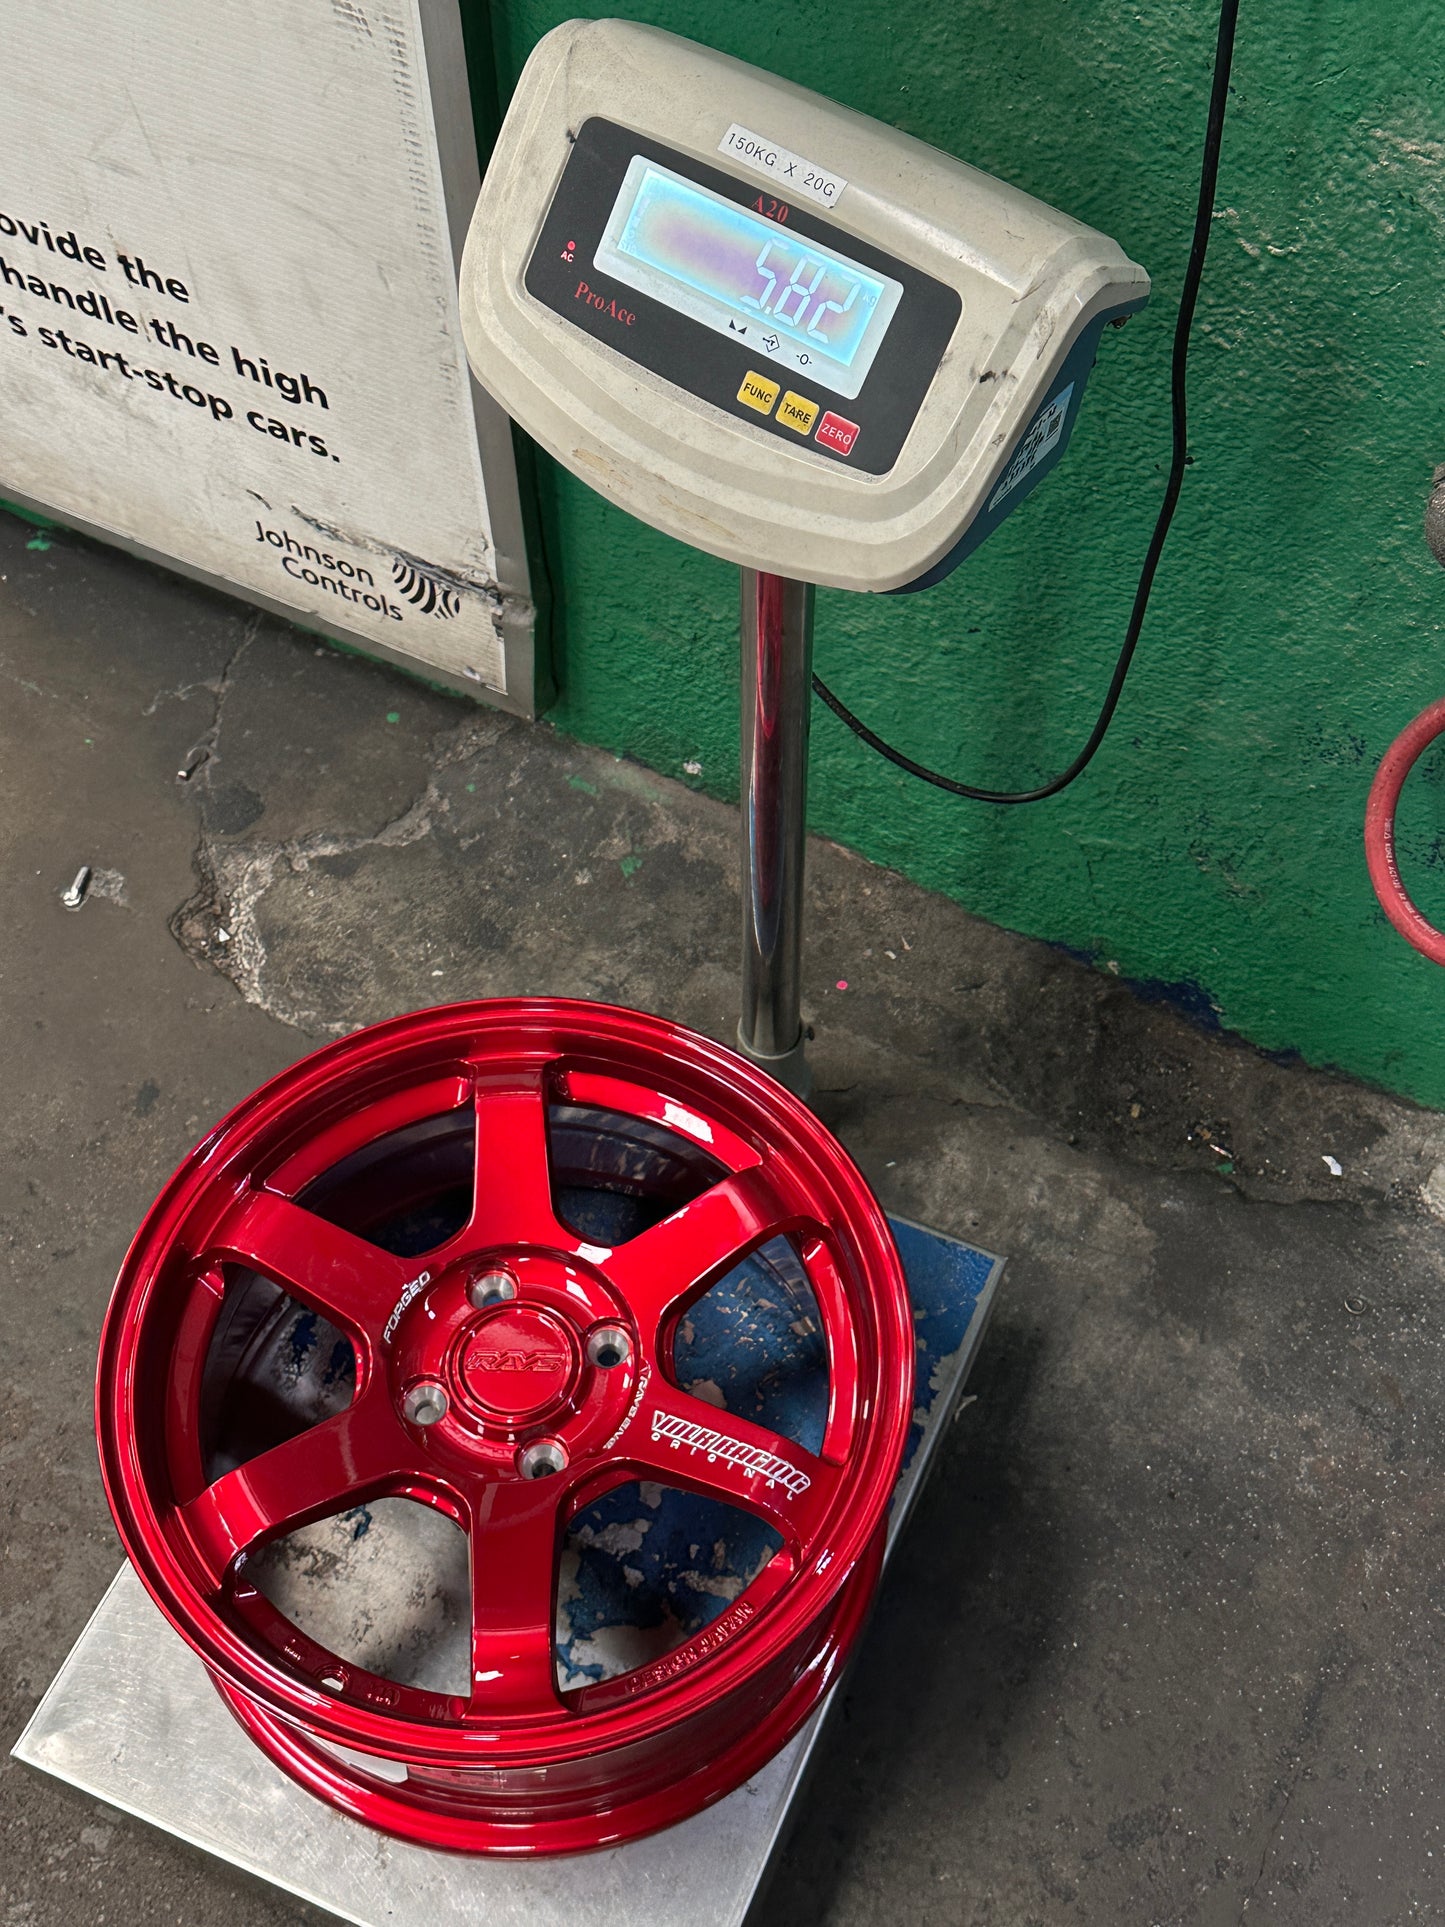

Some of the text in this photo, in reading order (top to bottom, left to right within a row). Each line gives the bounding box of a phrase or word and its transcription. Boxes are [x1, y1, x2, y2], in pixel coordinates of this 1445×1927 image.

[729, 133, 836, 197] 150KG X 20G
[751, 195, 789, 224] A20
[118, 254, 189, 303] the
[561, 251, 574, 262] AC
[574, 281, 636, 325] ProAce
[740, 237, 861, 344] 5.82
[0, 256, 329, 409] handle the high
[38, 327, 233, 420] start-stop
[247, 408, 340, 462] cars.
[743, 382, 772, 403] FUNC
[783, 403, 811, 424] TARE
[821, 424, 852, 445] ZERO
[256, 520, 375, 586] Johnson
[282, 556, 403, 621] Controls
[383, 1271, 431, 1344] FORGED
[466, 1350, 564, 1372] RAYS
[651, 1431, 793, 1501] ORIGINAL
